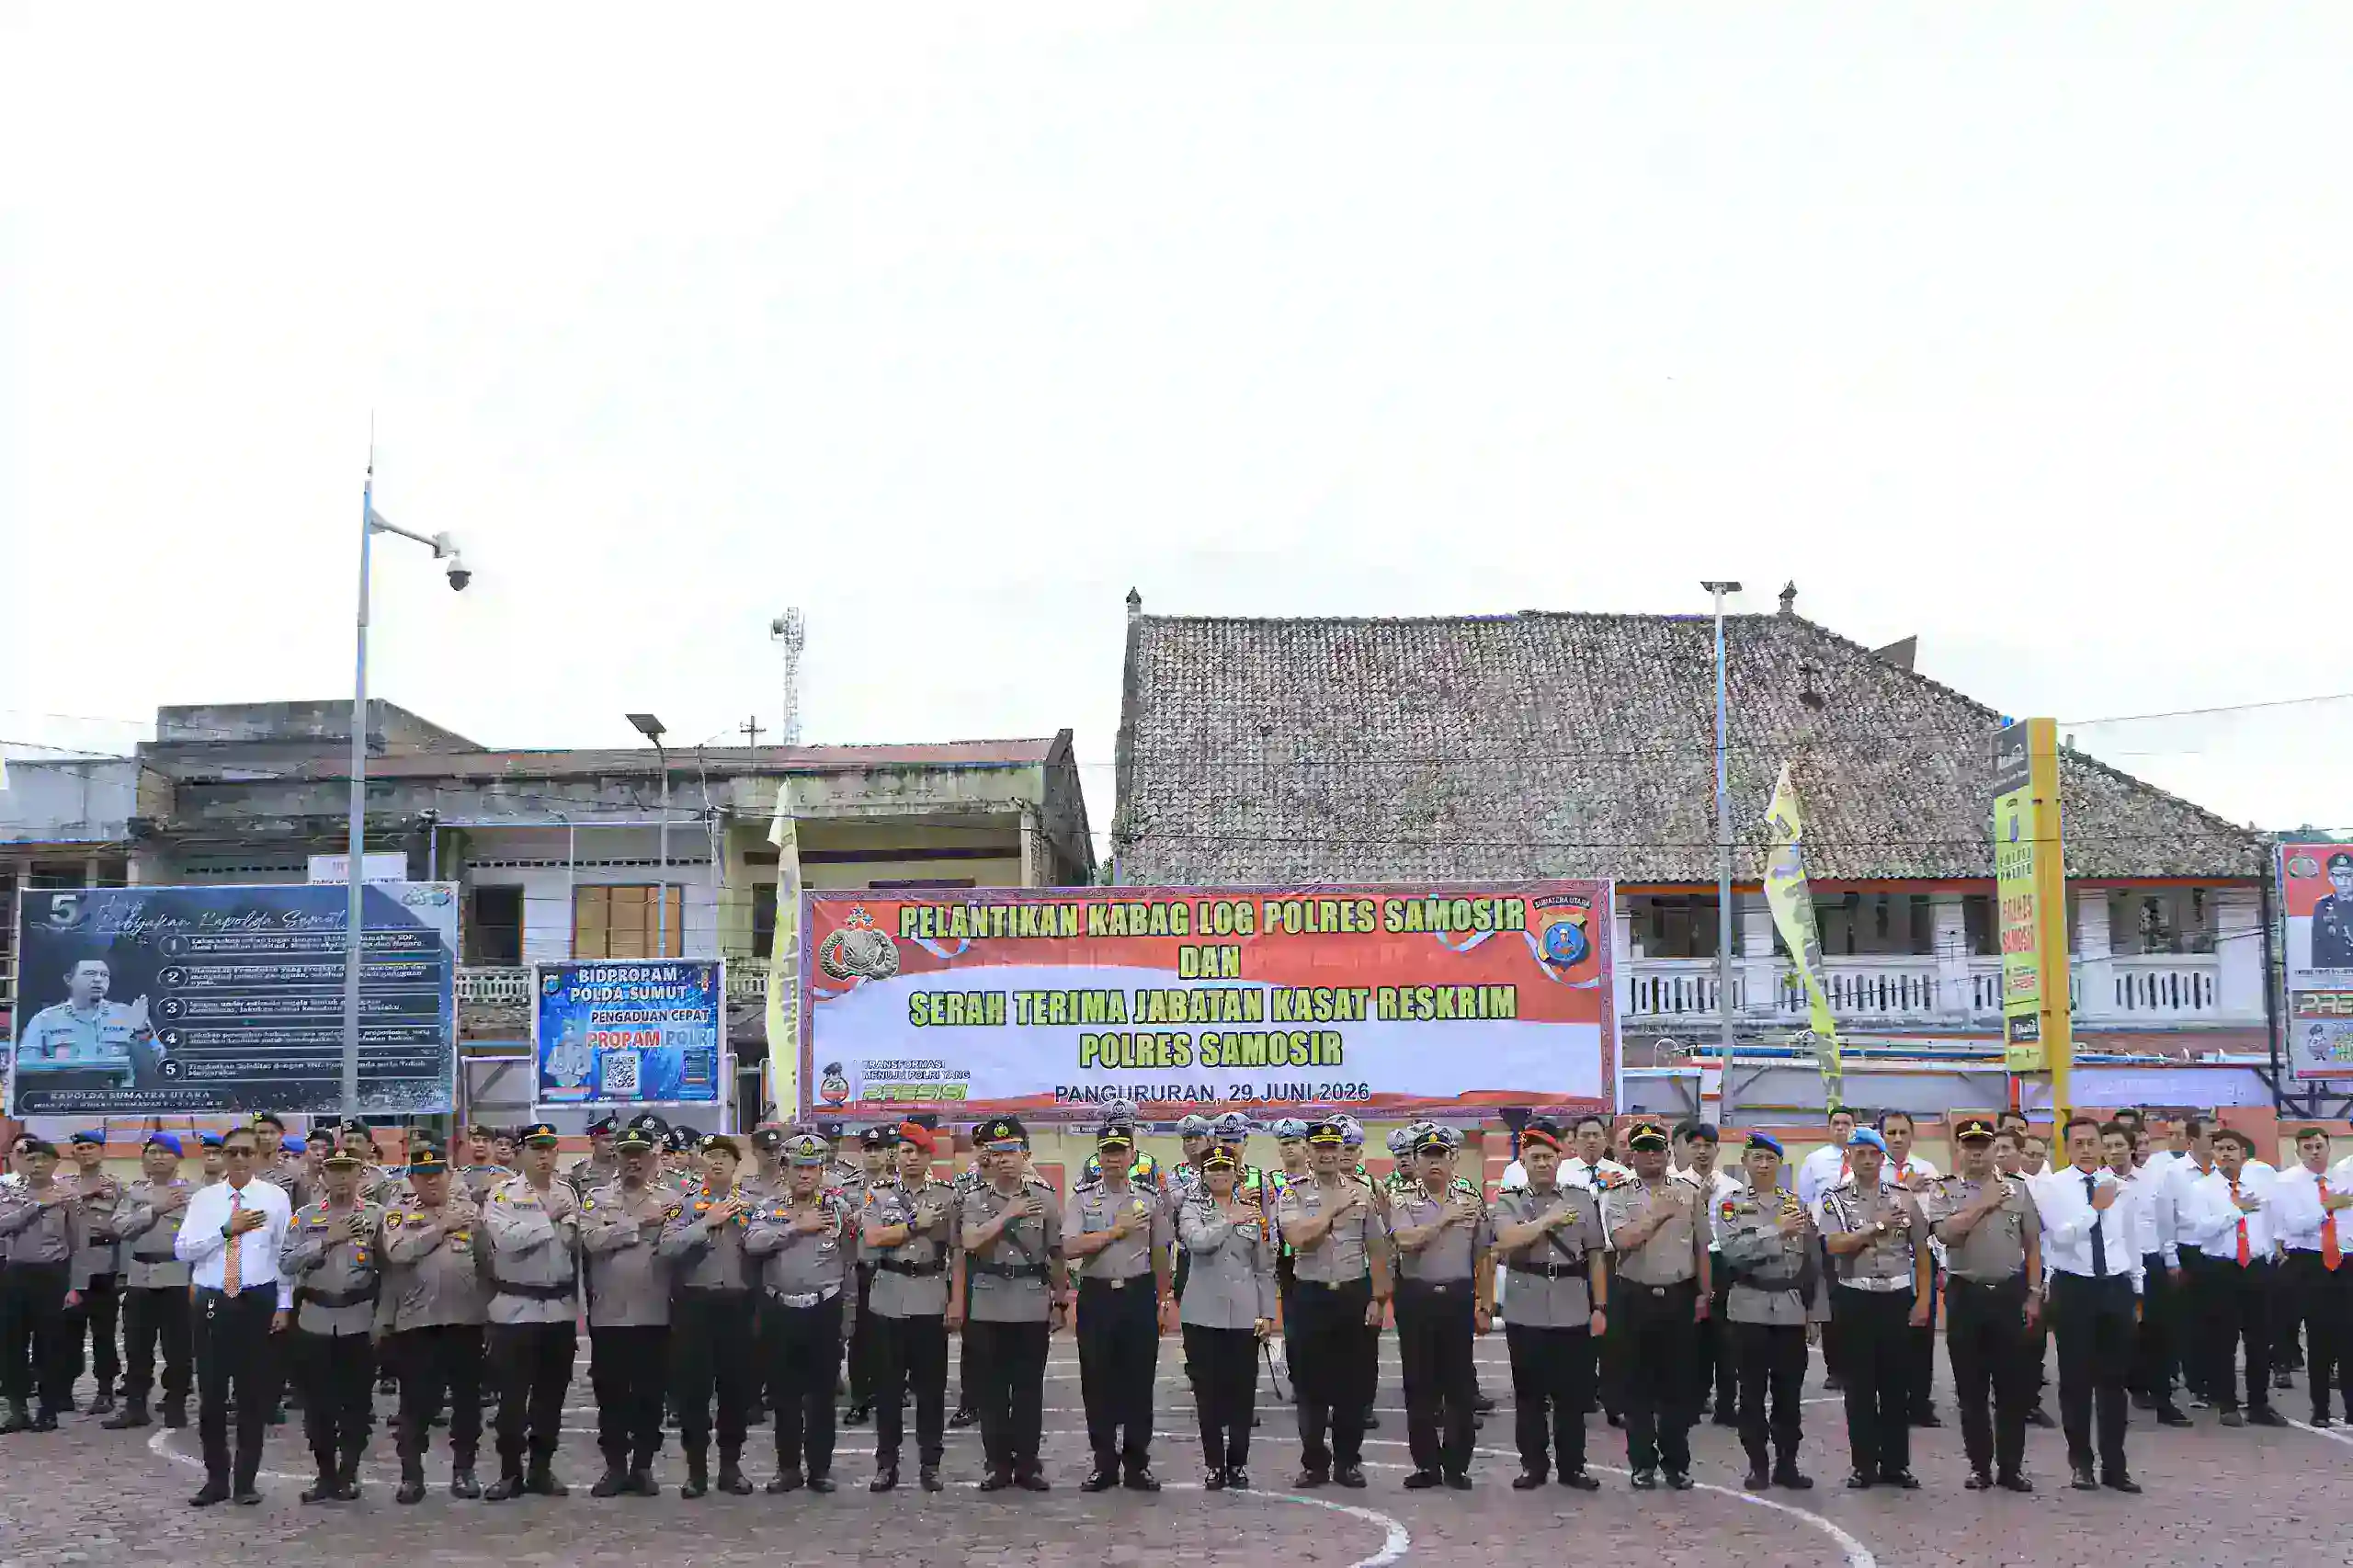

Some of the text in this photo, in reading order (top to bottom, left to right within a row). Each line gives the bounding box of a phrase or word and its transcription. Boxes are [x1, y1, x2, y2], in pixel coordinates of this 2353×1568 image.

[49, 894, 77, 923] 5
[1569, 896, 1590, 907] UTARA
[899, 897, 1526, 938] PELANTIKAN KABAG LOG POLRES SAMOSIR
[1178, 945, 1240, 980] DAN
[167, 971, 179, 983] 2
[578, 967, 677, 983] BIDPROPAM
[570, 985, 688, 1003] POLDA SUMUT
[166, 1001, 177, 1014] 3
[908, 984, 1518, 1027] SERAH TERIMA JABATAN KASAT RESKRIM
[591, 1009, 710, 1023] PENGADUAN CEPAT
[166, 1032, 177, 1044] 4
[585, 1028, 715, 1049] PROPAM POLRI
[1079, 1030, 1343, 1069] POLRES SAMOSIR
[165, 1063, 176, 1076] 5
[862, 1059, 946, 1070] TRANSFORMASI
[862, 1070, 971, 1081] MENUJU POLRI YANG
[1055, 1082, 1371, 1105] PANGURURAN, 29 JUNI 2026
